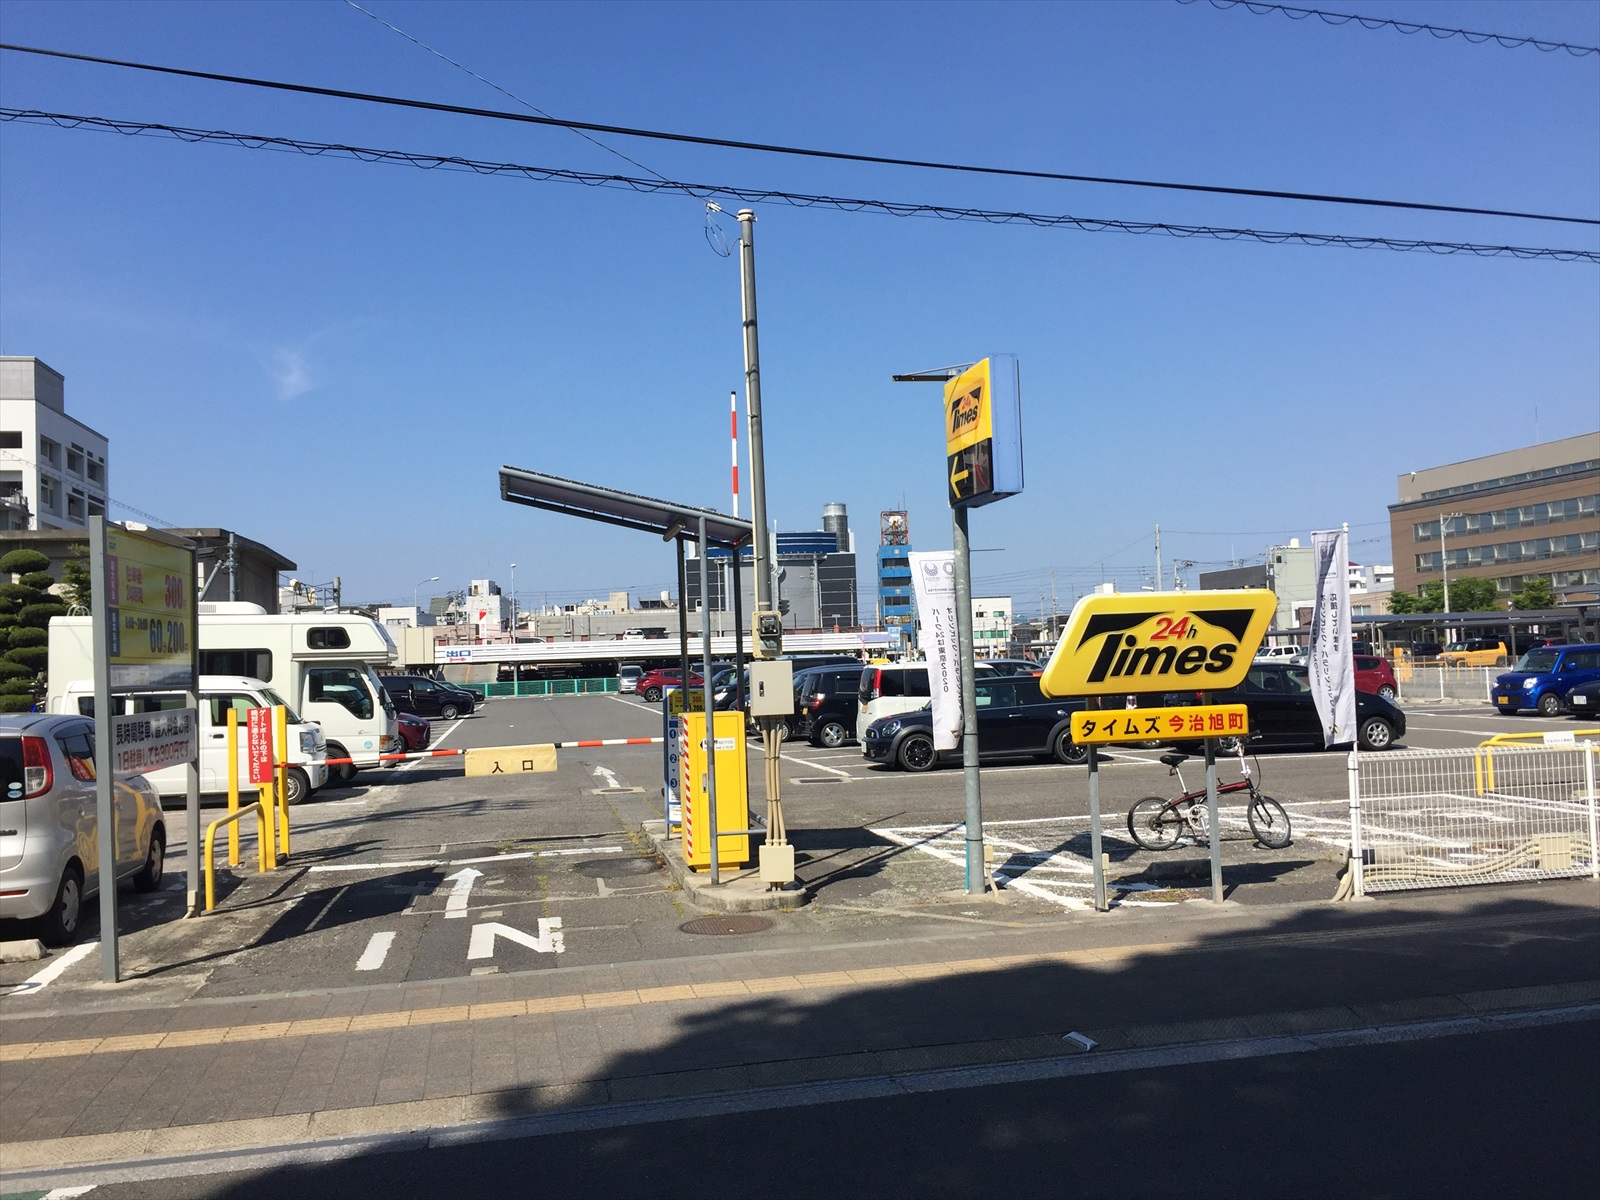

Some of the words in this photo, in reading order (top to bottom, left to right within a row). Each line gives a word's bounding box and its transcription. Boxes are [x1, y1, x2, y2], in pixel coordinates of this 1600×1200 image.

[952, 405, 979, 433] Times
[1150, 616, 1198, 641] 24h
[446, 650, 471, 658] 出口
[1086, 631, 1237, 684] Times
[1081, 716, 1161, 737] タイムズ
[1168, 712, 1244, 733] 今治旭町
[492, 760, 534, 773] 入口
